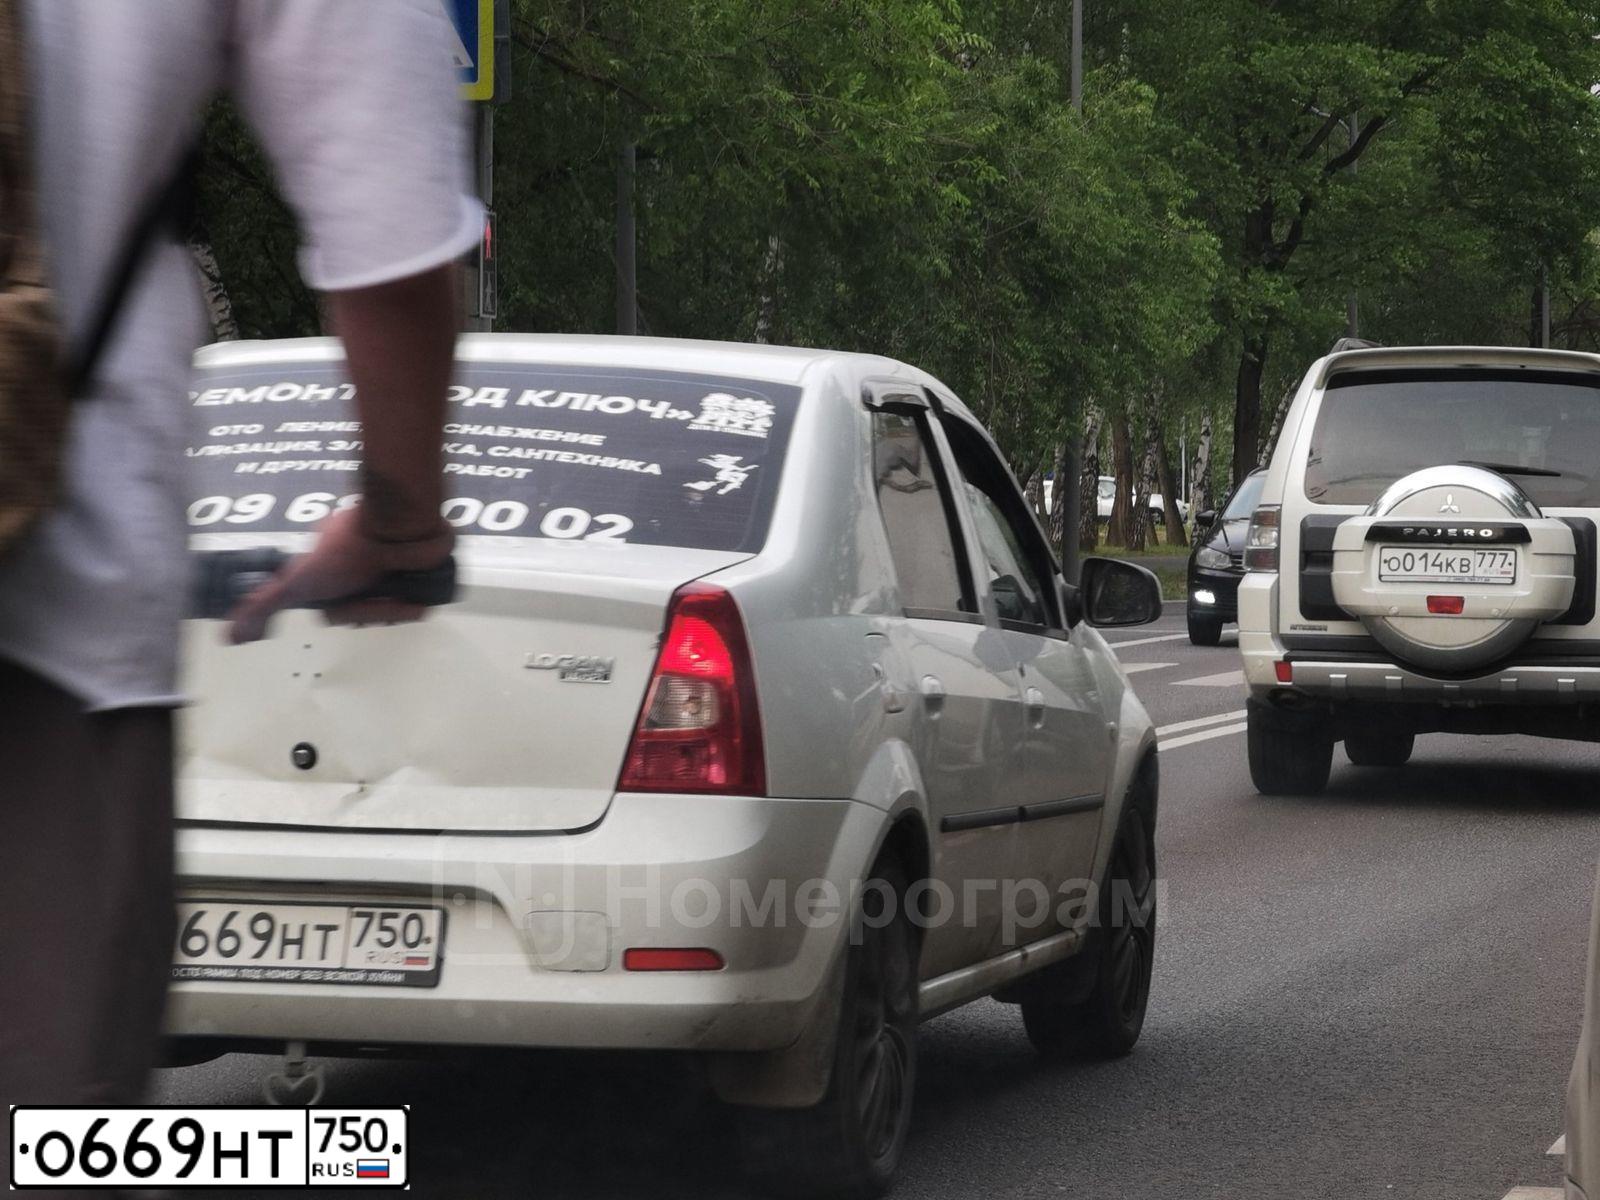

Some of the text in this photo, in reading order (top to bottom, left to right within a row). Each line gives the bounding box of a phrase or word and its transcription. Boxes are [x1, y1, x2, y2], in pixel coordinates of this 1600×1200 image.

[447, 385, 510, 409] ОД
[442, 423, 607, 446] СНАБЖЕНИЕ
[487, 446, 662, 475] САНТЕХНИКА
[540, 507, 634, 545] 02
[1403, 527, 1493, 537] PAJERO
[180, 910, 339, 960] 669НТ
